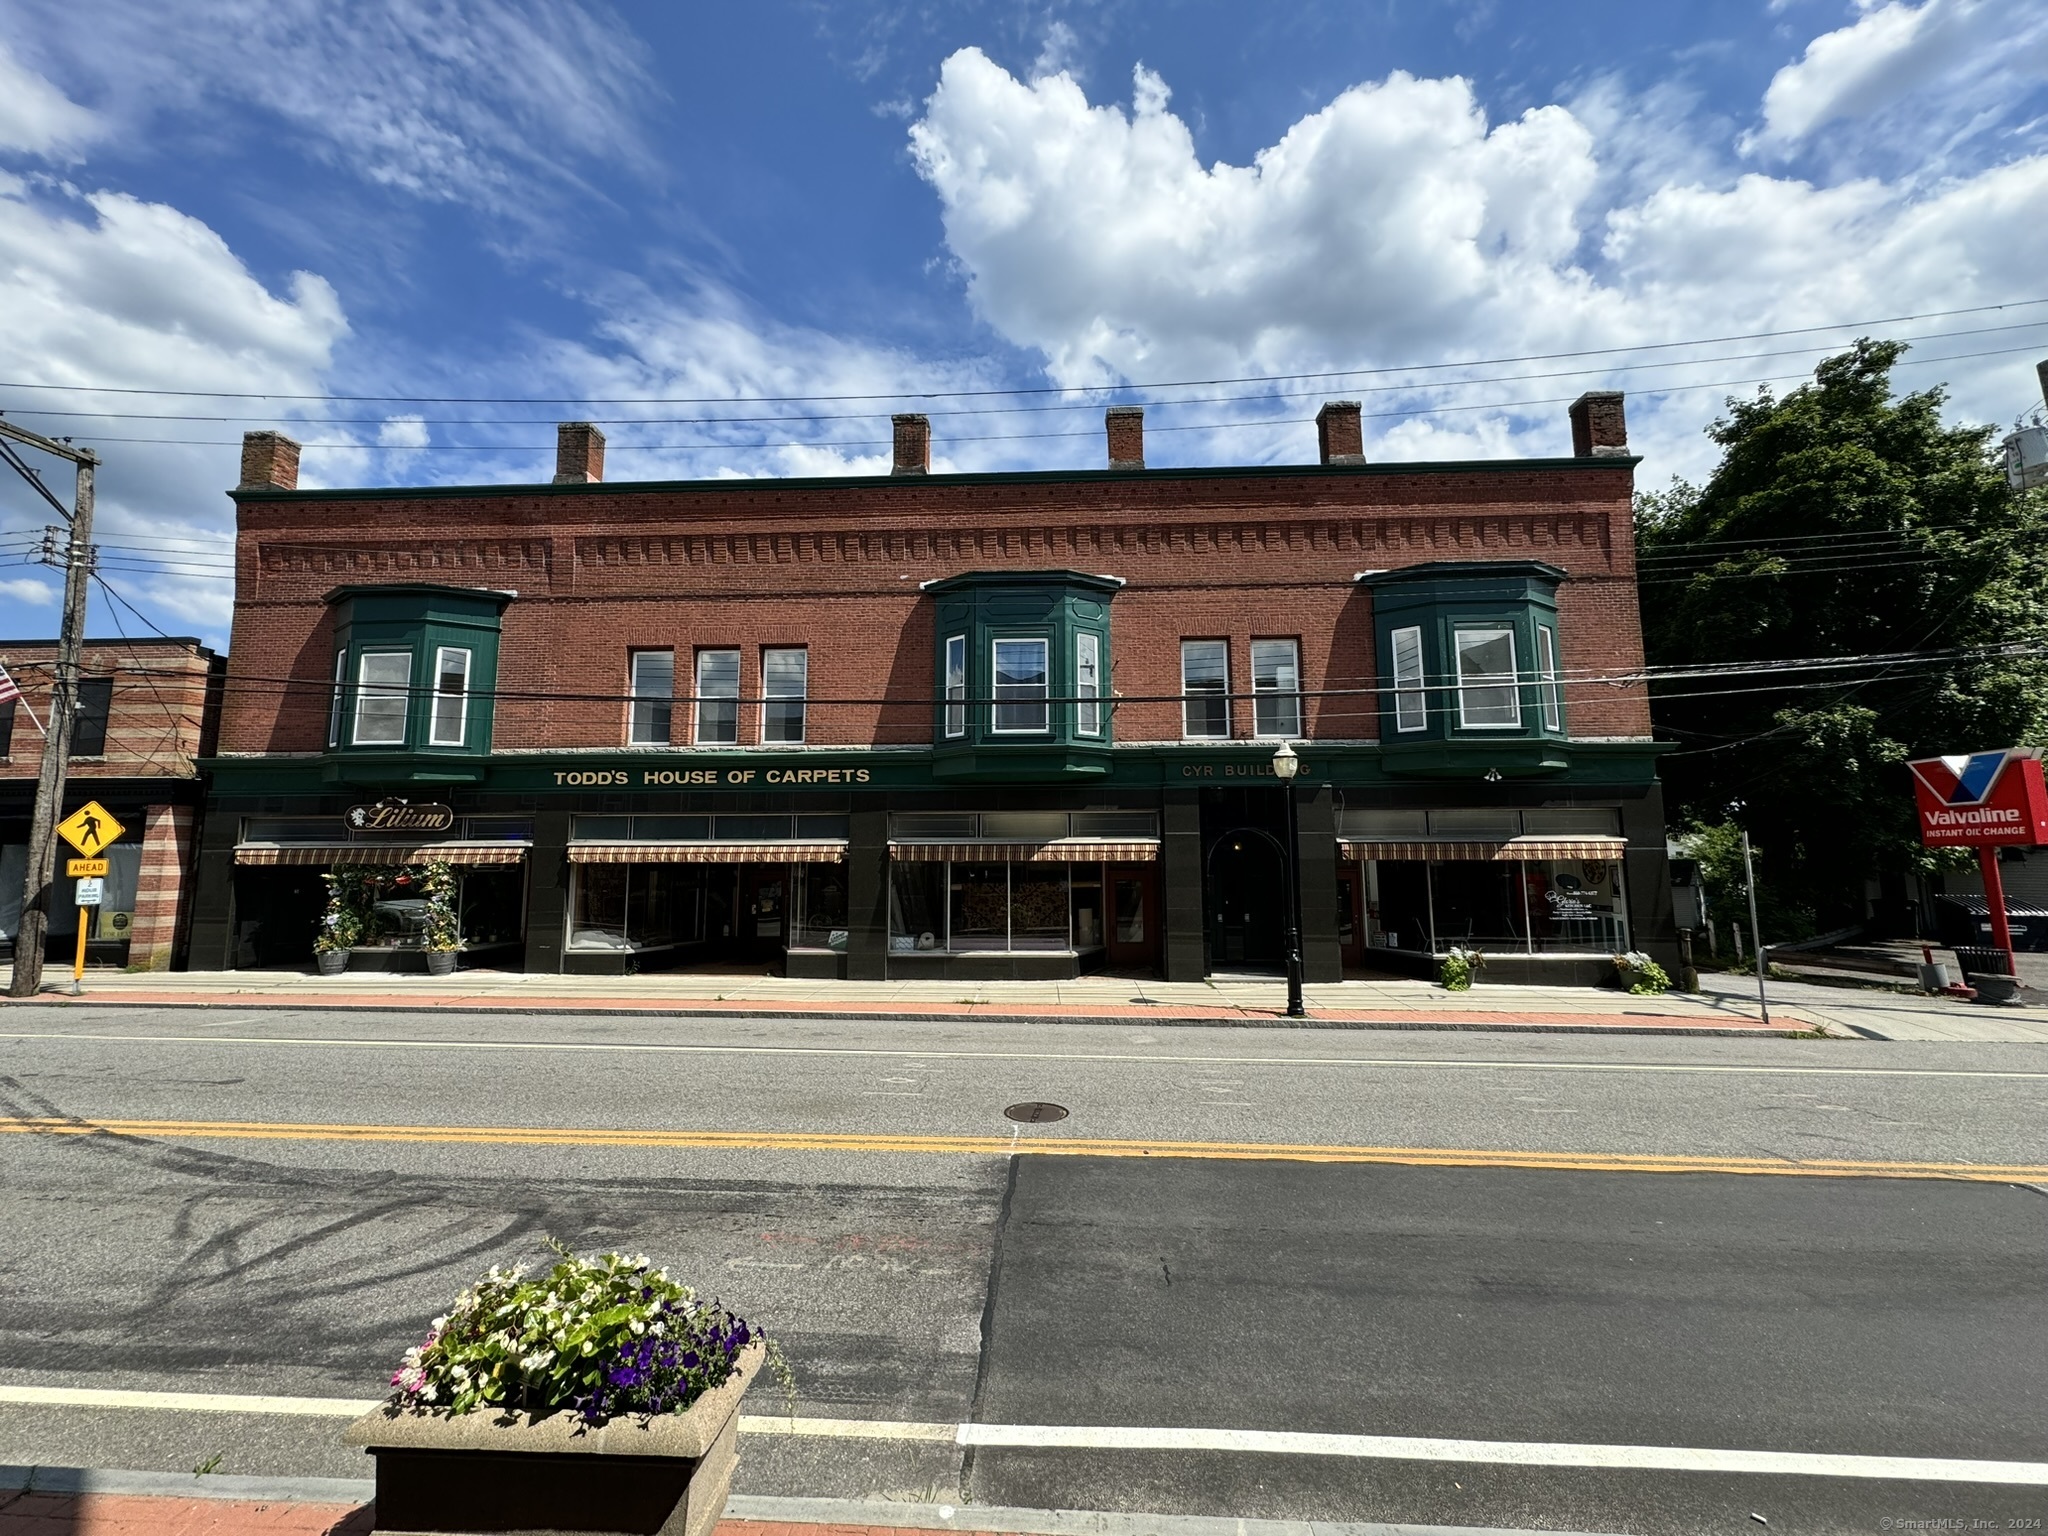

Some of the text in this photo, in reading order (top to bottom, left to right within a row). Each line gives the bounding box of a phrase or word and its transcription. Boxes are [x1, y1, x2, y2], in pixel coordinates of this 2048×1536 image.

[553, 769, 870, 785] TODD'S HOUSE OF CARPETS
[1182, 764, 1311, 777] CYR BUILDG
[365, 806, 445, 829] Lilium
[1924, 807, 2020, 826] Valvoline
[1926, 826, 2026, 838] INSTANT OIL CHANGE
[72, 863, 104, 872] AHEAD
